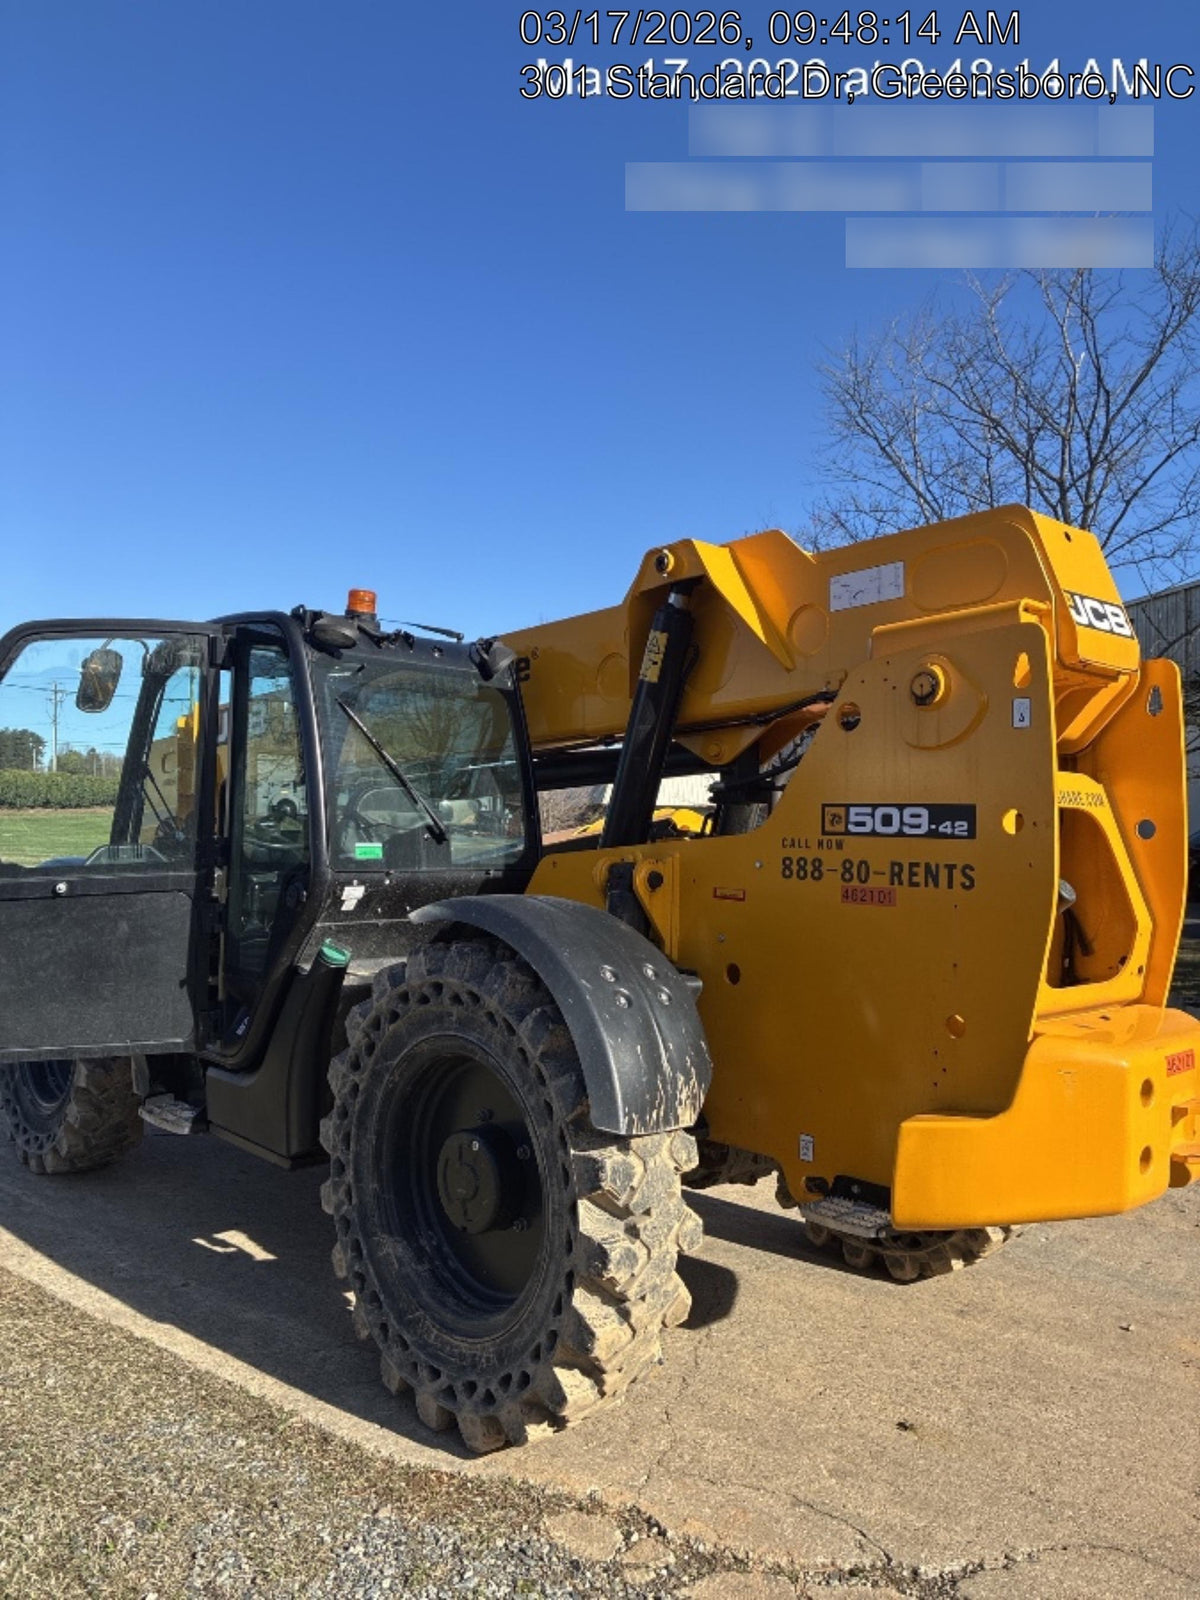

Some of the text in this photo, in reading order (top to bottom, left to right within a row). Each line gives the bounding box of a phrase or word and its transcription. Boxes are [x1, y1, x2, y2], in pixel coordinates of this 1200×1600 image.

[1070, 594, 1133, 637] JCB
[848, 806, 969, 837] 509-42
[781, 838, 845, 850] CALL NOW
[781, 856, 976, 891] 888-80-RENTS
[842, 888, 894, 905] 462101
